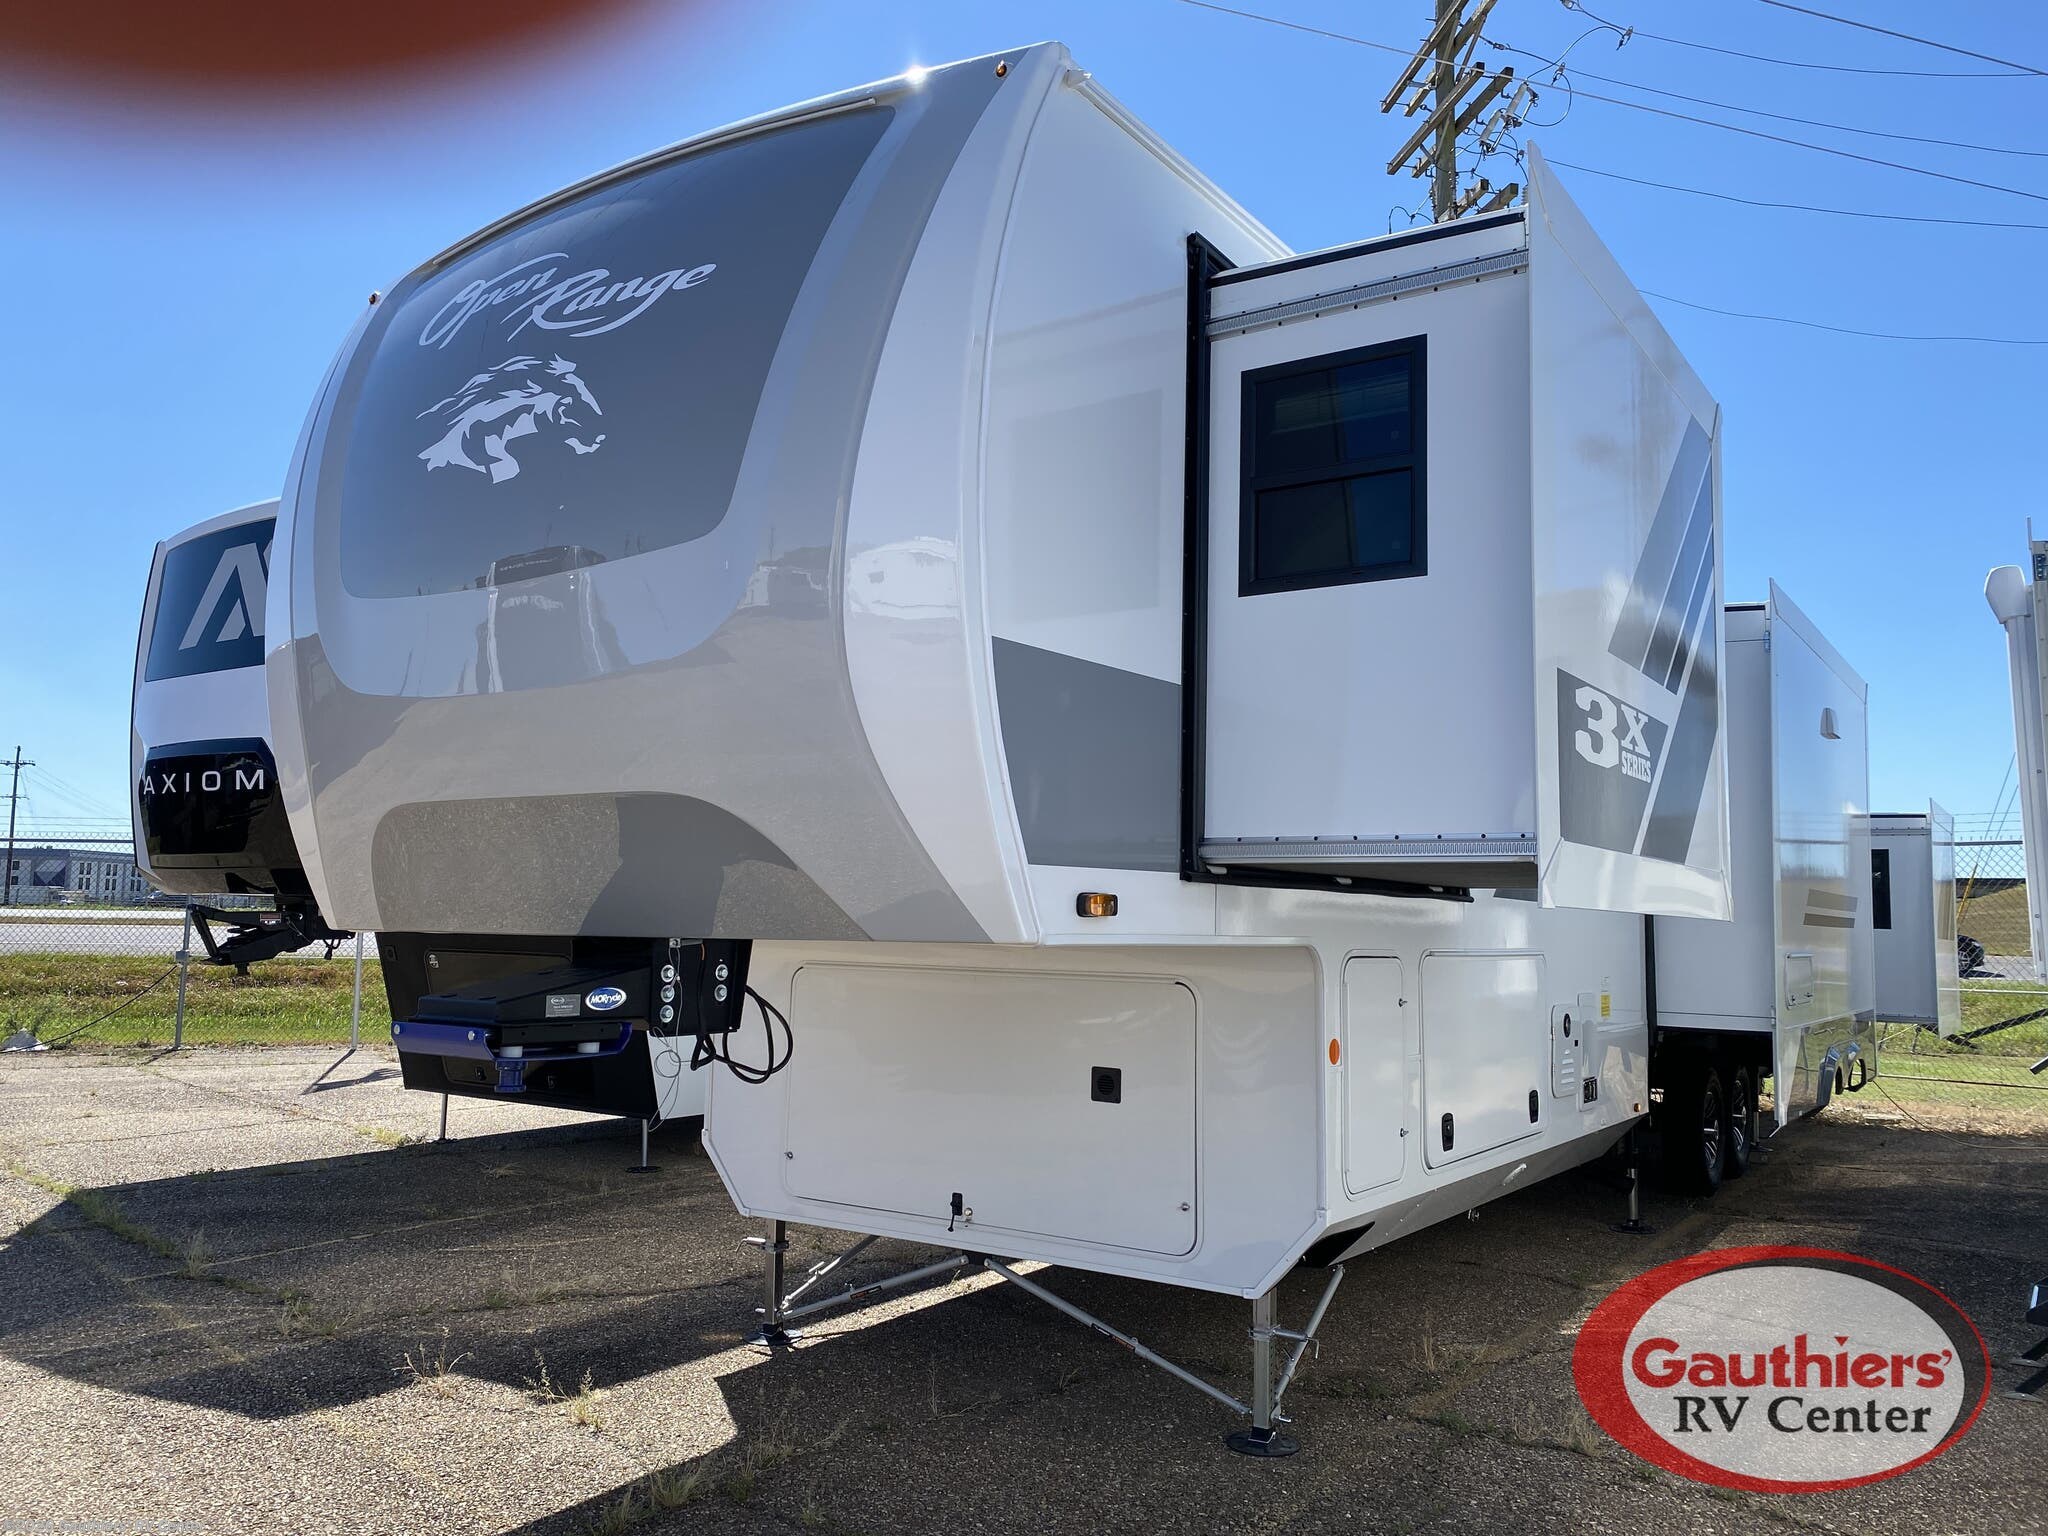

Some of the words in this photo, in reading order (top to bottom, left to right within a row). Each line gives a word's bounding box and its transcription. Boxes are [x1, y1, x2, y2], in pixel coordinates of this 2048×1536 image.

[419, 253, 569, 349] Open
[500, 263, 717, 342] Range
[1575, 686, 1651, 768] 3X
[143, 769, 264, 795] AXIOM
[1621, 750, 1652, 783] SERIES
